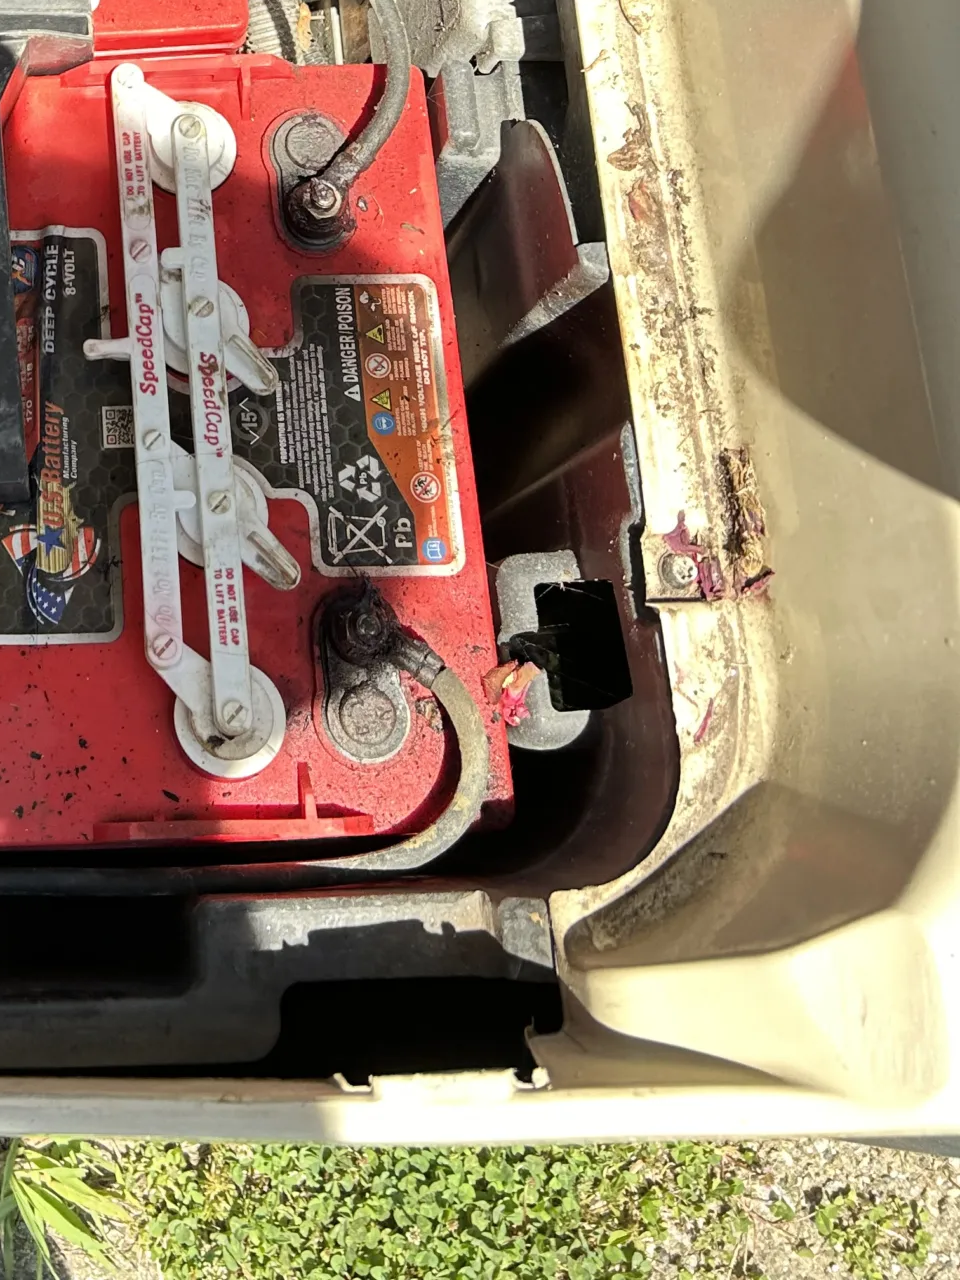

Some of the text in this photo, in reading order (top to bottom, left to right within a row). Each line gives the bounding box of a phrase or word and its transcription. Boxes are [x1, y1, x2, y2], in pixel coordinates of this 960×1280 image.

[122, 132, 134, 196] DO NOT USE CAP
[133, 131, 145, 196] TO LIFT BATTERY
[64, 248, 76, 296] 8-VOLT
[44, 245, 59, 353] DEEP CYCLE
[407, 290, 417, 324] SHOCK
[335, 287, 360, 383] DANGER/POISON
[413, 340, 421, 362] RISK
[420, 329, 430, 385] DO NOT TIP.
[415, 364, 425, 406] VOLTAGE
[241, 411, 258, 430] 15
[276, 413, 285, 421] 65
[40, 401, 64, 482] Battery
[61, 417, 70, 479] Manufacturing
[69, 439, 78, 479] Company
[277, 422, 288, 464] PROPOSITION
[359, 472, 367, 484] Pb
[394, 517, 413, 548] Pb
[214, 569, 228, 646] TO LIFT BATTERY
[225, 568, 240, 646] DO NOT USE CAP
